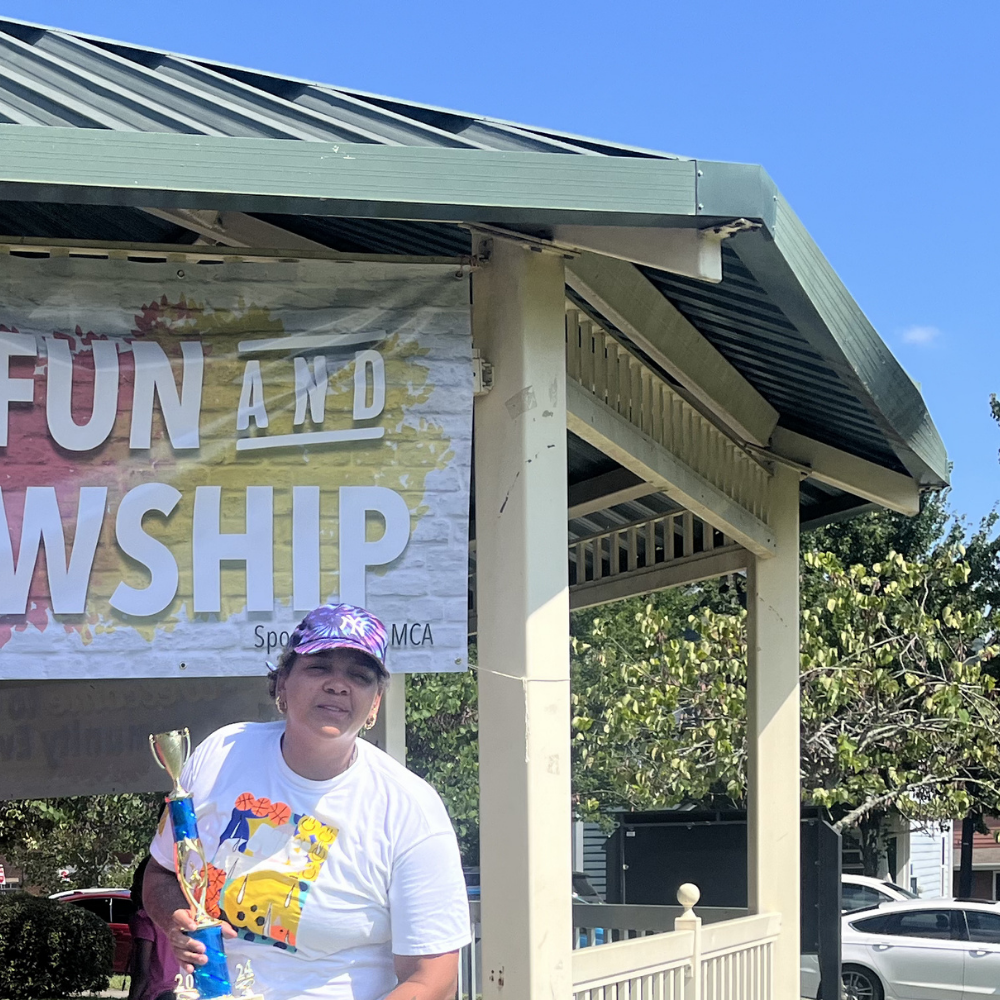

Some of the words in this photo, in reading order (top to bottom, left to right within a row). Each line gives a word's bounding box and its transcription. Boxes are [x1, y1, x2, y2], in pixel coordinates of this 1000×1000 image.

[236, 349, 386, 432] AND
[391, 622, 434, 646] MCA
[173, 973, 195, 993] 20
